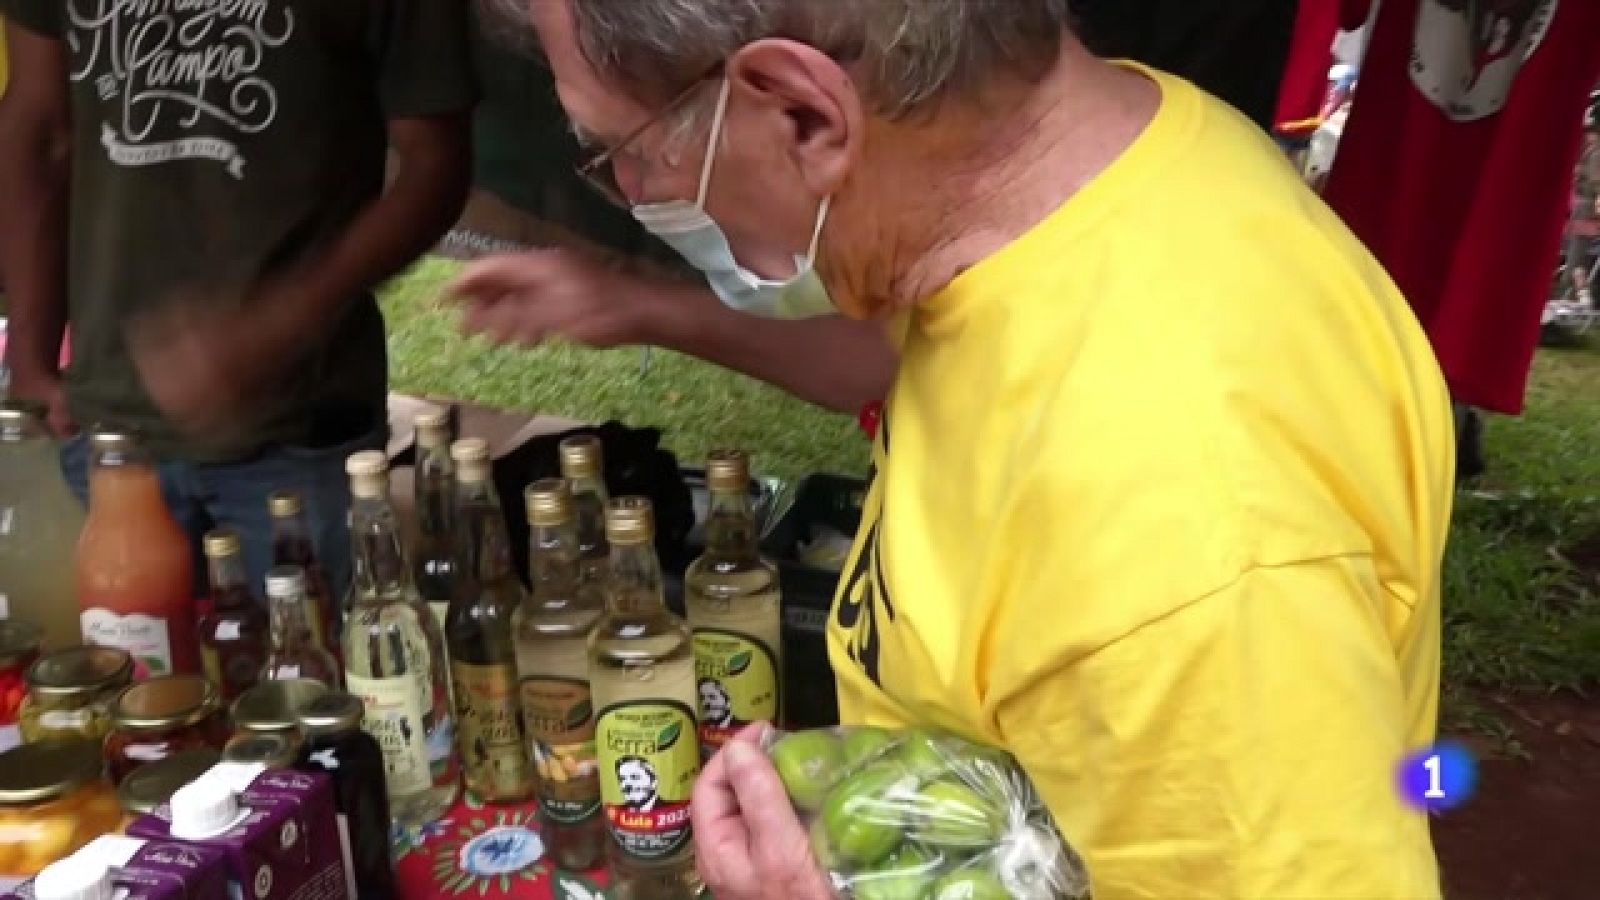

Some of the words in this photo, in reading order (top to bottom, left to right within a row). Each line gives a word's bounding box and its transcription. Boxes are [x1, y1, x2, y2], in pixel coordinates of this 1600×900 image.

[123, 14, 270, 128] Campo
[606, 729, 656, 755] terra
[619, 811, 654, 829] Lula
